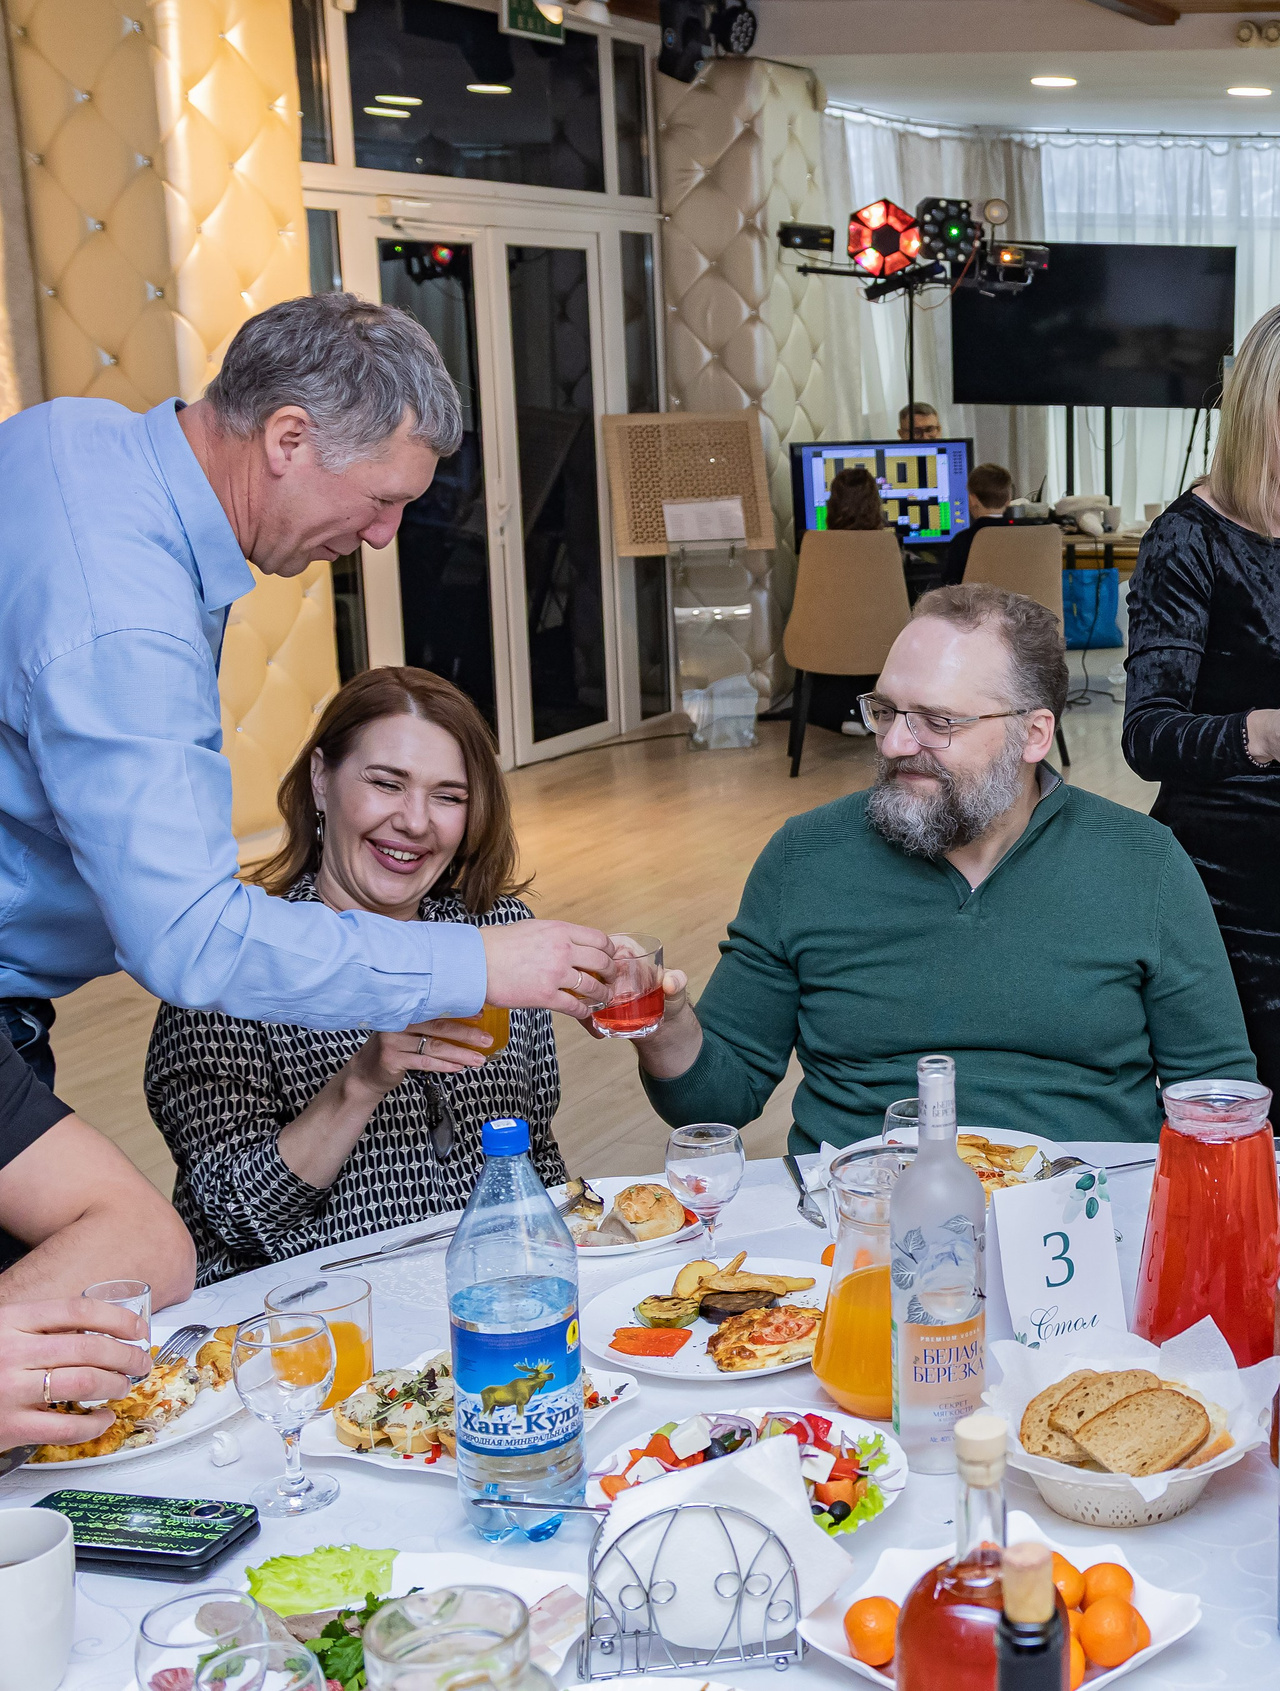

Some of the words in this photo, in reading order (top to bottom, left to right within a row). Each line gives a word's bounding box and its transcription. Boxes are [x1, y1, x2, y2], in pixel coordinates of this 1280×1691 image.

[1043, 1231, 1075, 1288] 3
[1029, 1305, 1100, 1344] Стол
[920, 1334, 957, 1342] PREMIUM
[923, 1340, 978, 1365] БЕЛАЯ
[932, 1404, 974, 1418] МЯГКОСТИ
[938, 1400, 968, 1410] СЕКРЕТ
[461, 1402, 580, 1436] Хан-Куль
[504, 1425, 570, 1447] МИНЕРАЛЬНАЯ
